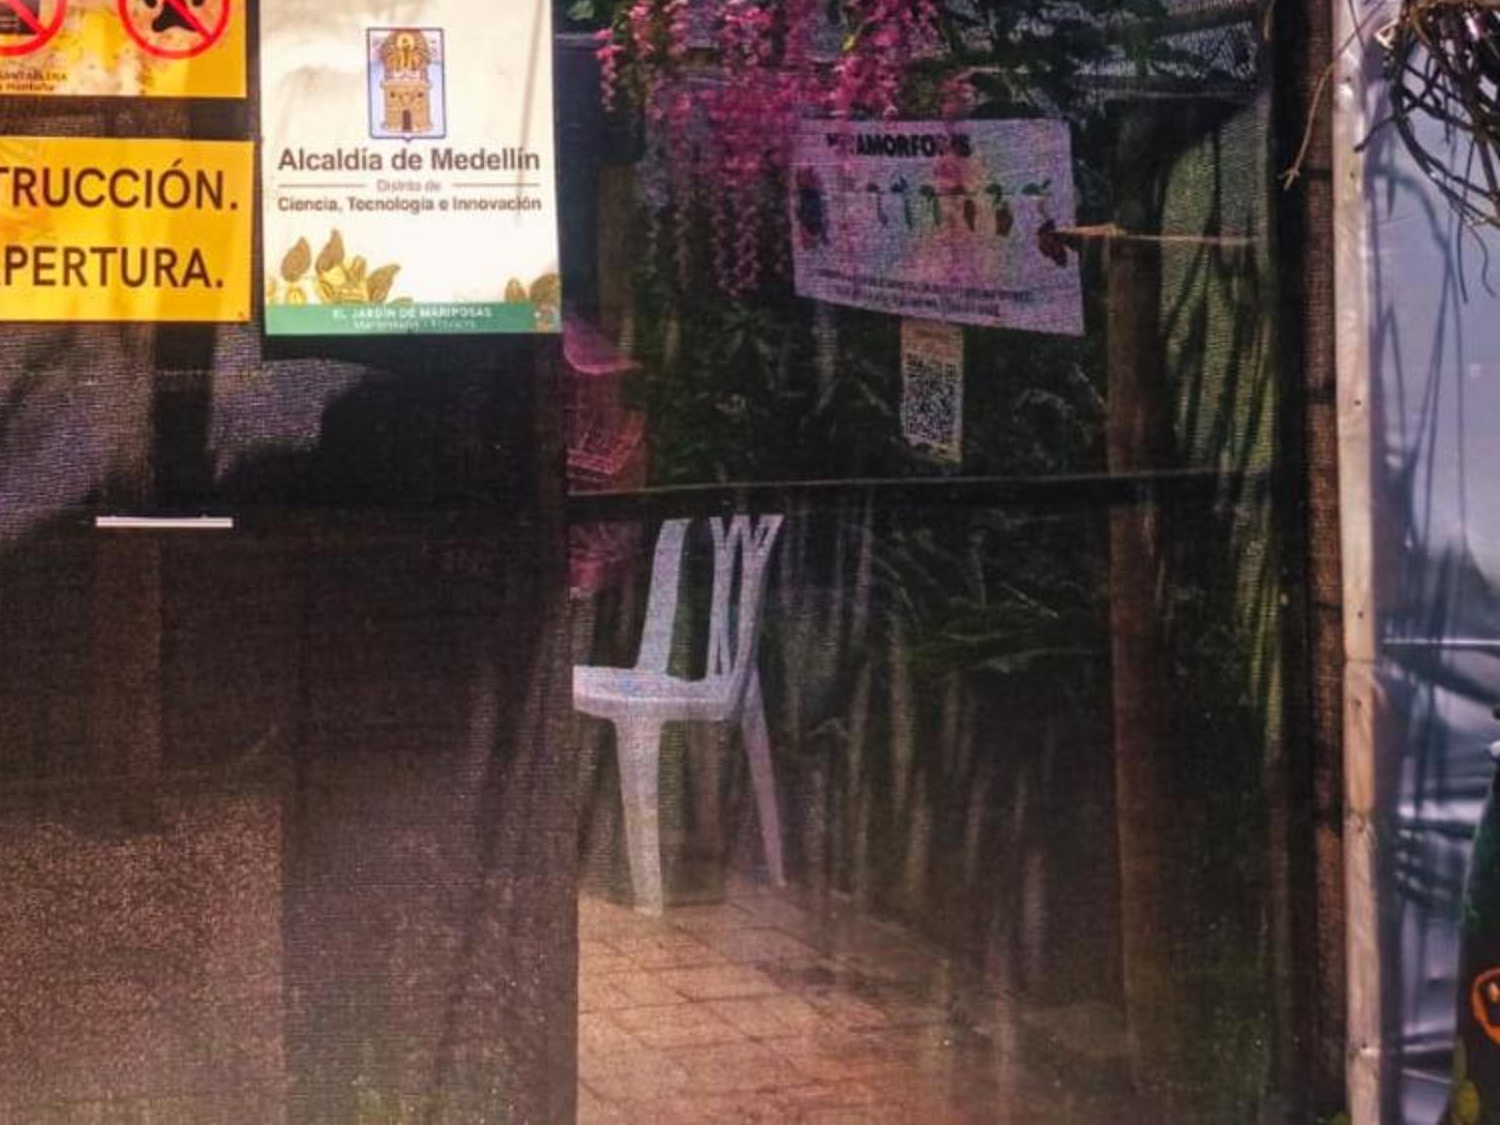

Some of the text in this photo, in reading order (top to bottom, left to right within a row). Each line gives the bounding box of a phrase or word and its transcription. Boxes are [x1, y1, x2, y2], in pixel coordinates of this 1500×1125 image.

[277, 147, 540, 171] Alcaldía de Medellín
[376, 178, 441, 192] Distrito de
[277, 195, 343, 214] Ciencia,
[439, 199, 449, 211] e
[419, 306, 492, 318] MARIPOSAS
